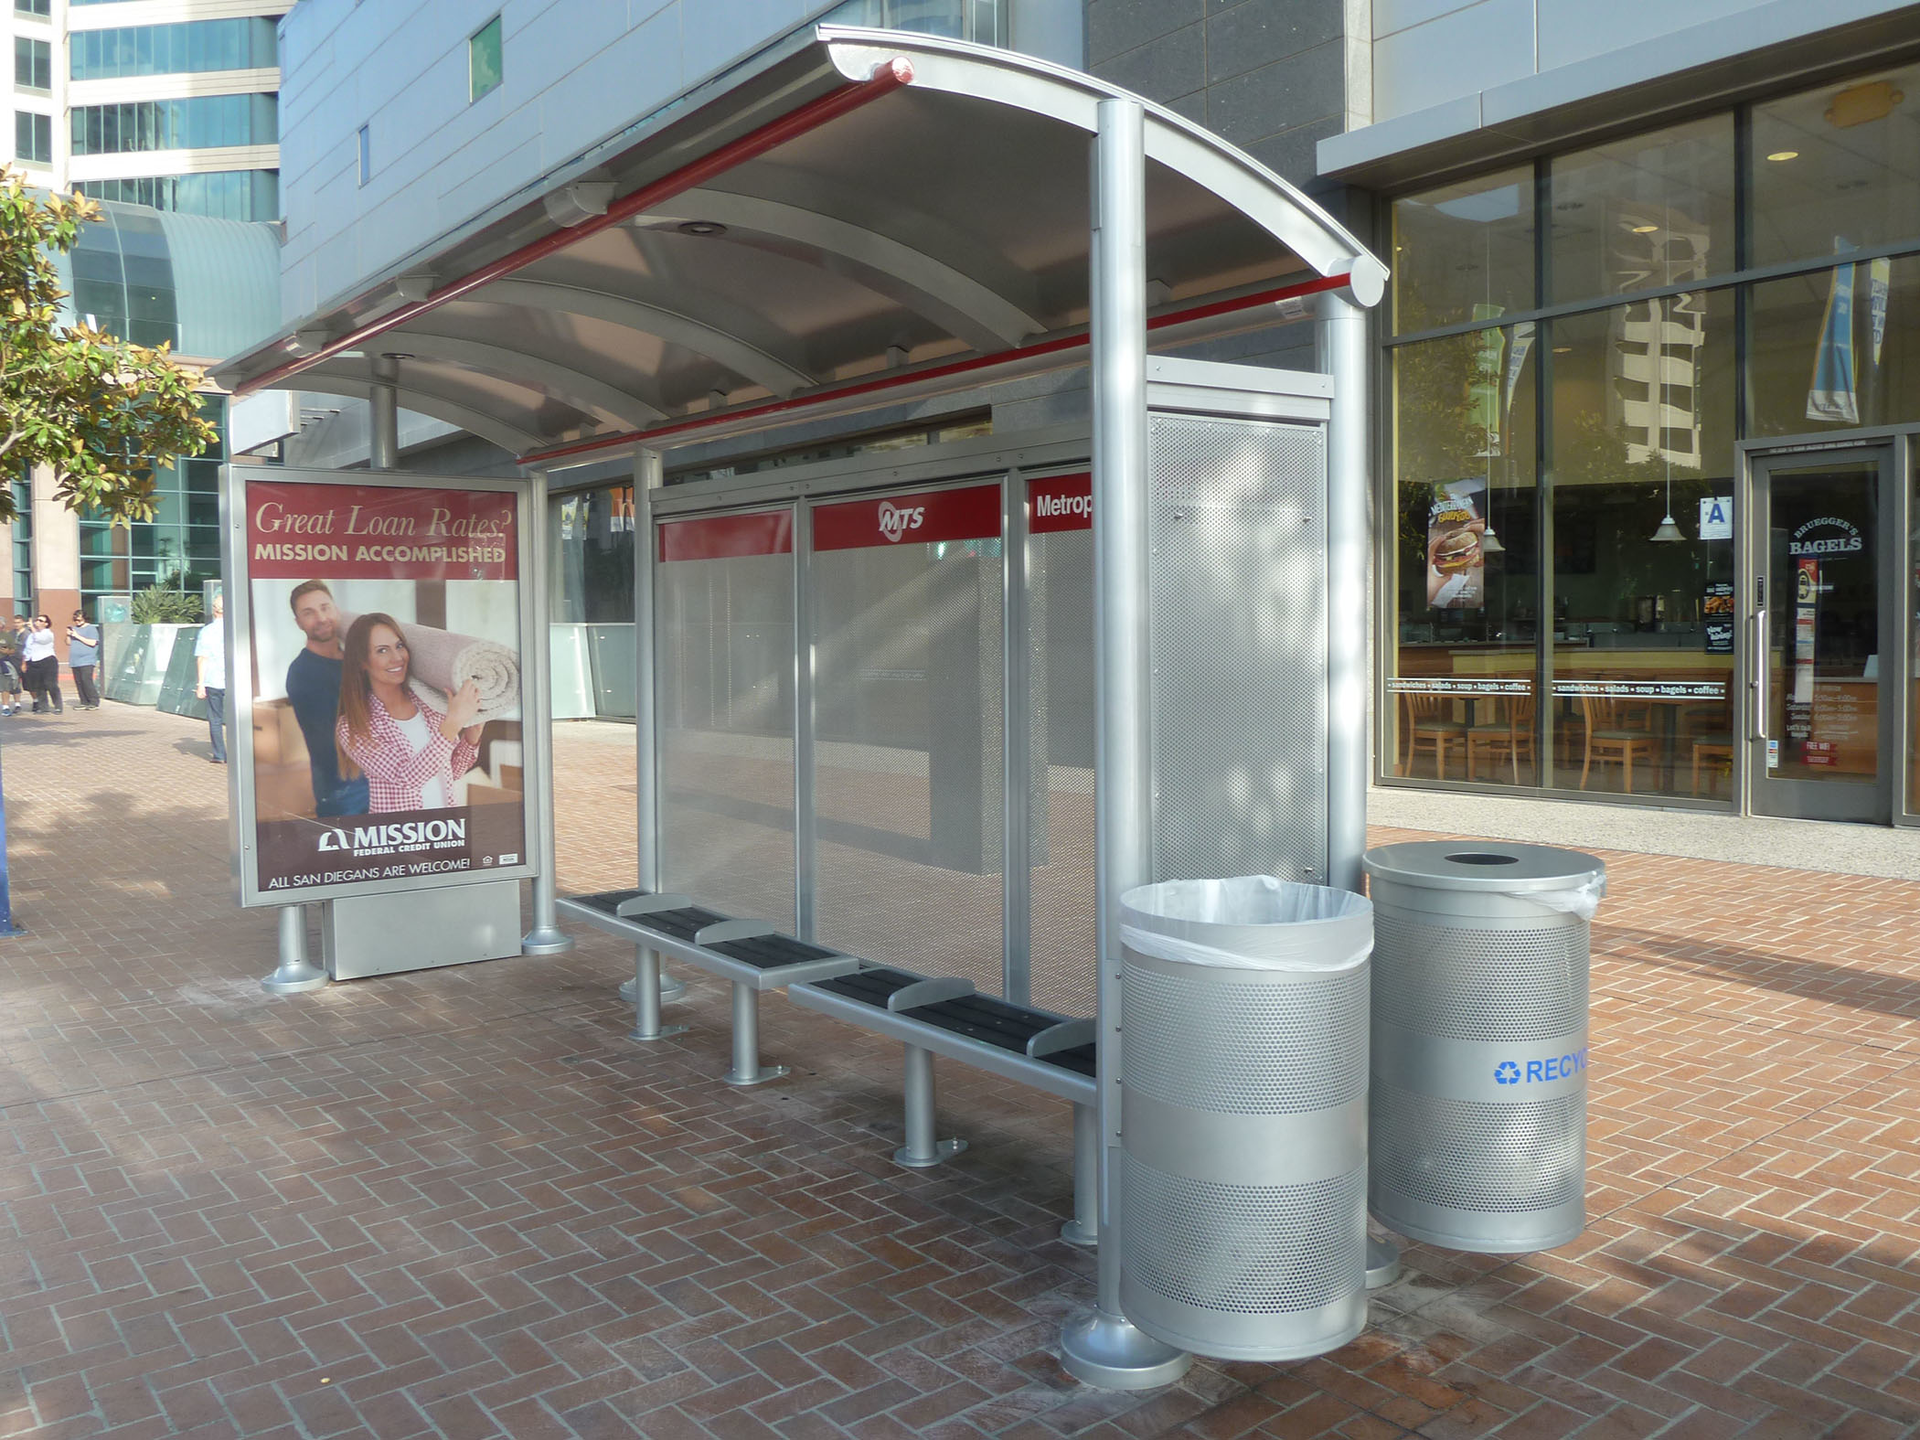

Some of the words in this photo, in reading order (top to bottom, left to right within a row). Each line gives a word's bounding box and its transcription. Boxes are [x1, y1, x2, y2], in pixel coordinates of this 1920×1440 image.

[1037, 494, 1093, 518] Metrop
[1707, 503, 1725, 523] A
[255, 501, 335, 535] Great
[344, 505, 416, 536] Loan
[425, 507, 512, 538] Rates?
[879, 505, 925, 532] MTS
[1794, 517, 1859, 539] BRUEGGER'S
[255, 543, 348, 562] MISSION
[355, 545, 506, 563] ACCOMPLISHED
[1789, 537, 1862, 555] BAGELS
[1392, 681, 1426, 689] sandwiches
[1457, 683, 1472, 691] soup
[1477, 682, 1499, 691] bagels
[1505, 683, 1525, 691] coffee
[1557, 684, 1598, 693] sandwiches
[1604, 684, 1629, 693] salads
[1635, 686, 1654, 694] soup
[1660, 685, 1686, 695] bagels
[1693, 686, 1719, 695] coffee
[353, 818, 466, 849] MISSION
[353, 846, 395, 857] FEDERAL
[398, 843, 431, 853] CREDIT
[434, 839, 465, 849] UNION
[268, 877, 290, 889] ALL
[293, 872, 321, 886] SAN
[324, 867, 380, 883] DIEGANS
[382, 864, 405, 877] ARE
[408, 858, 471, 874] WELCOME!
